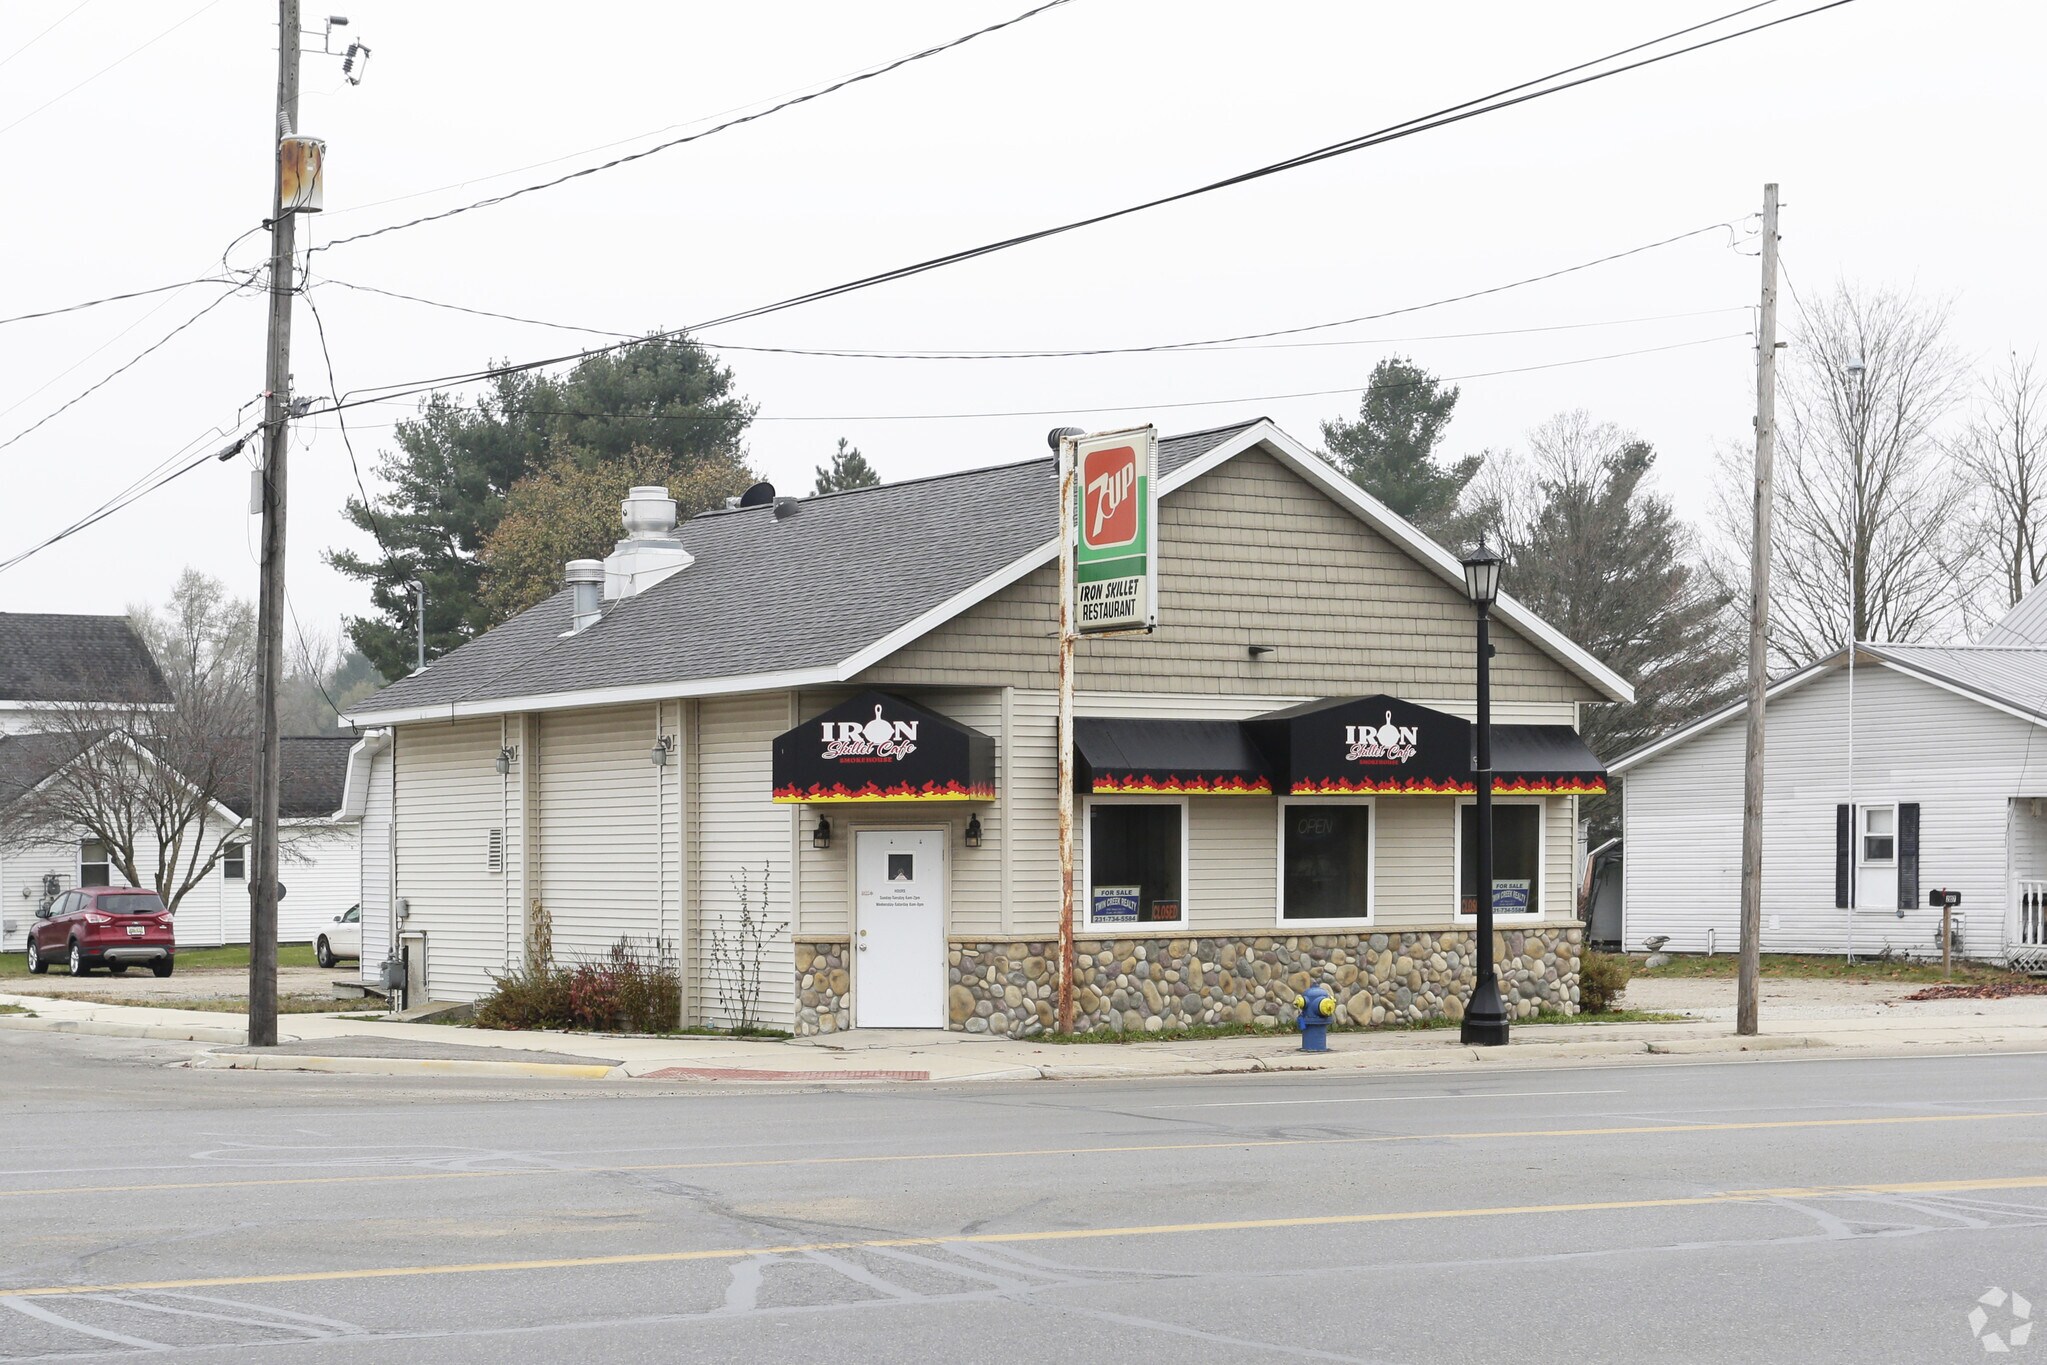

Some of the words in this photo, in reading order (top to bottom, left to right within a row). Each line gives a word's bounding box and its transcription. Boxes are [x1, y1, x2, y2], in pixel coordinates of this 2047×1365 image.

[1088, 461, 1134, 537] 7UP
[1080, 584, 1103, 602] IRON
[1105, 578, 1139, 600] SKILLET
[1082, 599, 1137, 621] RESTAURANT
[821, 719, 919, 743] IRON
[1345, 724, 1418, 746] IRON
[821, 741, 875, 760] Skillet
[876, 740, 917, 761] Cafe
[1345, 743, 1386, 761] Skillet
[1297, 818, 1333, 834] OPEN
[1120, 897, 1137, 911] REALTY
[1152, 904, 1178, 920] CLOSED
